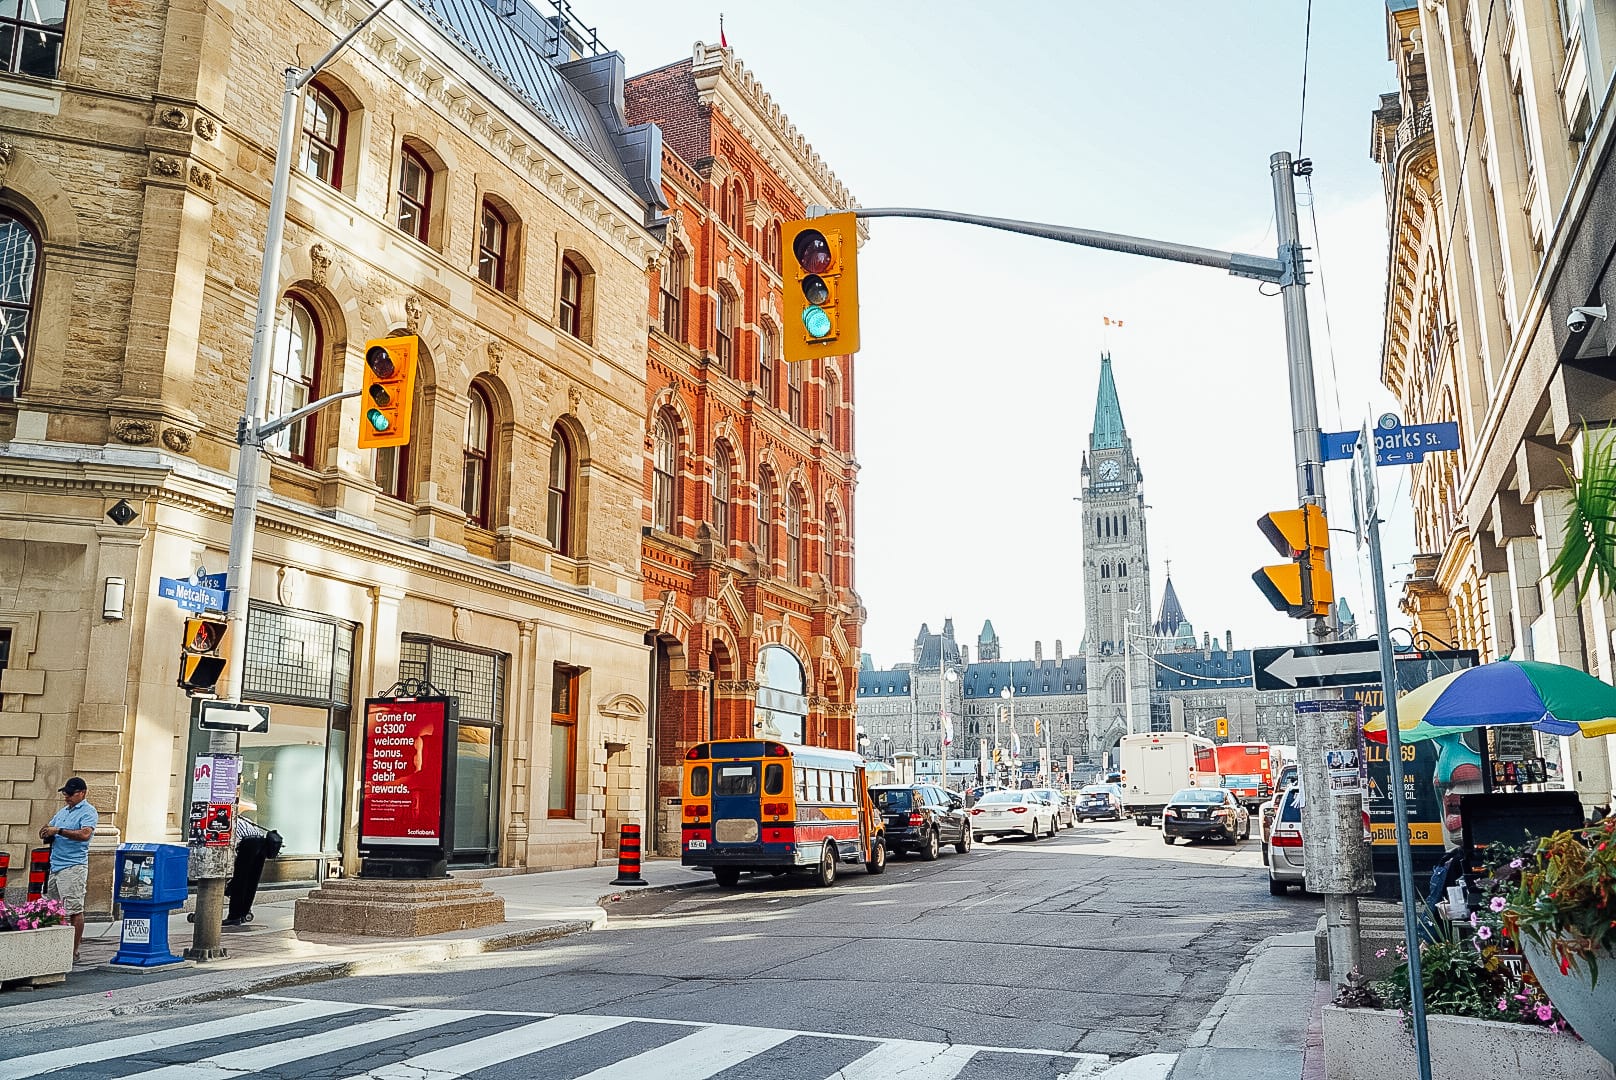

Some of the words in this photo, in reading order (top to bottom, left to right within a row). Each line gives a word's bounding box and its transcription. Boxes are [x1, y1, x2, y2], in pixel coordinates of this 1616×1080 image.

[1375, 429, 1421, 454] parks
[1425, 433, 1441, 445] St.
[1406, 452, 1414, 460] 93
[165, 587, 175, 597] rue
[176, 585, 209, 604] Metcalfe
[375, 713, 401, 722] Come
[403, 712, 416, 722] for
[374, 726, 382, 734] a
[374, 736, 414, 746] welcome
[373, 748, 403, 758] bonus.
[373, 760, 392, 772] Stay
[394, 761, 407, 770] for
[372, 772, 395, 782] debit
[371, 784, 410, 794] rewards.
[129, 843, 145, 851] FREE
